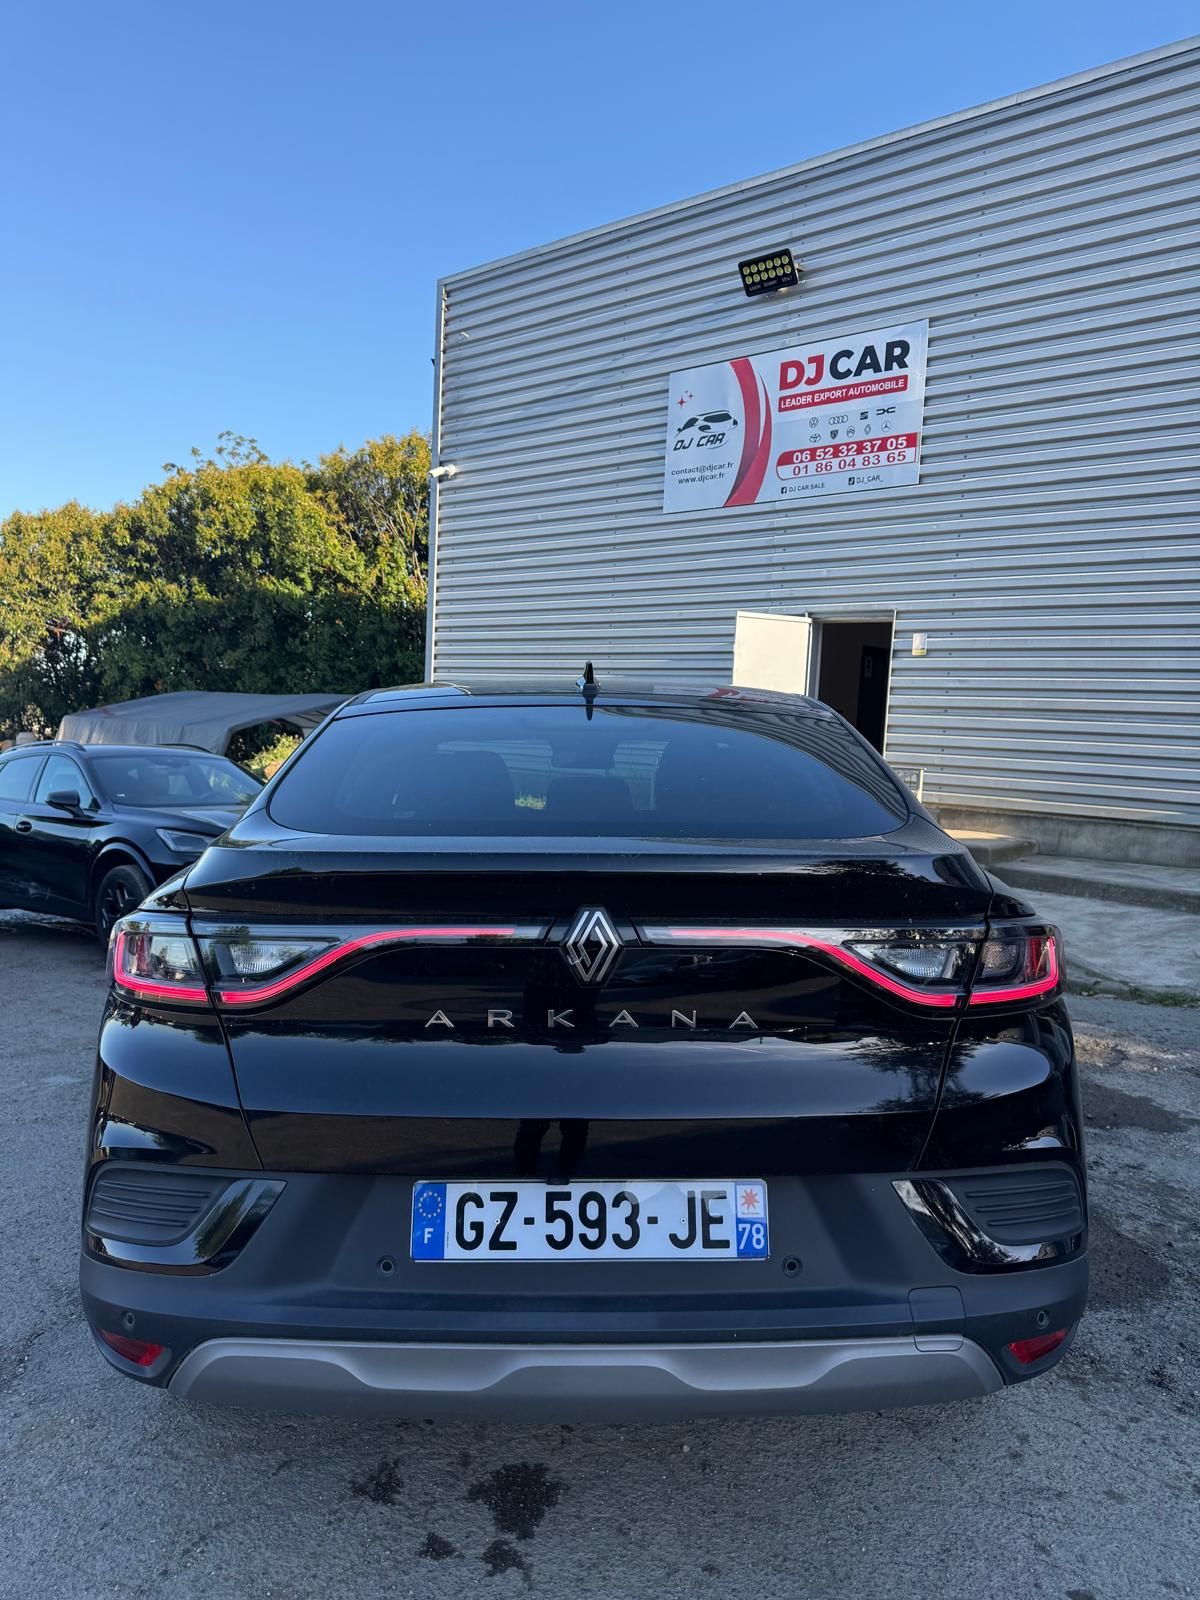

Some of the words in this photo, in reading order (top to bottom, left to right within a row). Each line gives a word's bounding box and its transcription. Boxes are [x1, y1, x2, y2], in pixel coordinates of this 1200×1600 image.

[779, 354, 825, 391] DJ
[829, 339, 911, 380] CAR
[781, 394, 813, 408] LEADER
[814, 388, 847, 403] EXPORT
[848, 378, 905, 396] AUTOMOBILE
[673, 437, 694, 451] DJ
[696, 432, 726, 448] CAR
[793, 450, 811, 463] 06
[815, 447, 834, 460] 52
[838, 444, 857, 457] 32
[862, 440, 882, 453] 37
[886, 436, 907, 449] 05
[671, 461, 734, 476] contact@djcar.fr
[793, 463, 809, 476] 01
[815, 461, 833, 473] 86
[838, 458, 857, 470] 04
[862, 454, 881, 466] 83
[886, 450, 906, 463] 65
[678, 472, 724, 484] www.djcar.fr
[424, 1009, 759, 1029] ARKANA
[455, 1190, 731, 1251] GZ-593-JE
[424, 1227, 434, 1244] F
[738, 1223, 765, 1250] 78
